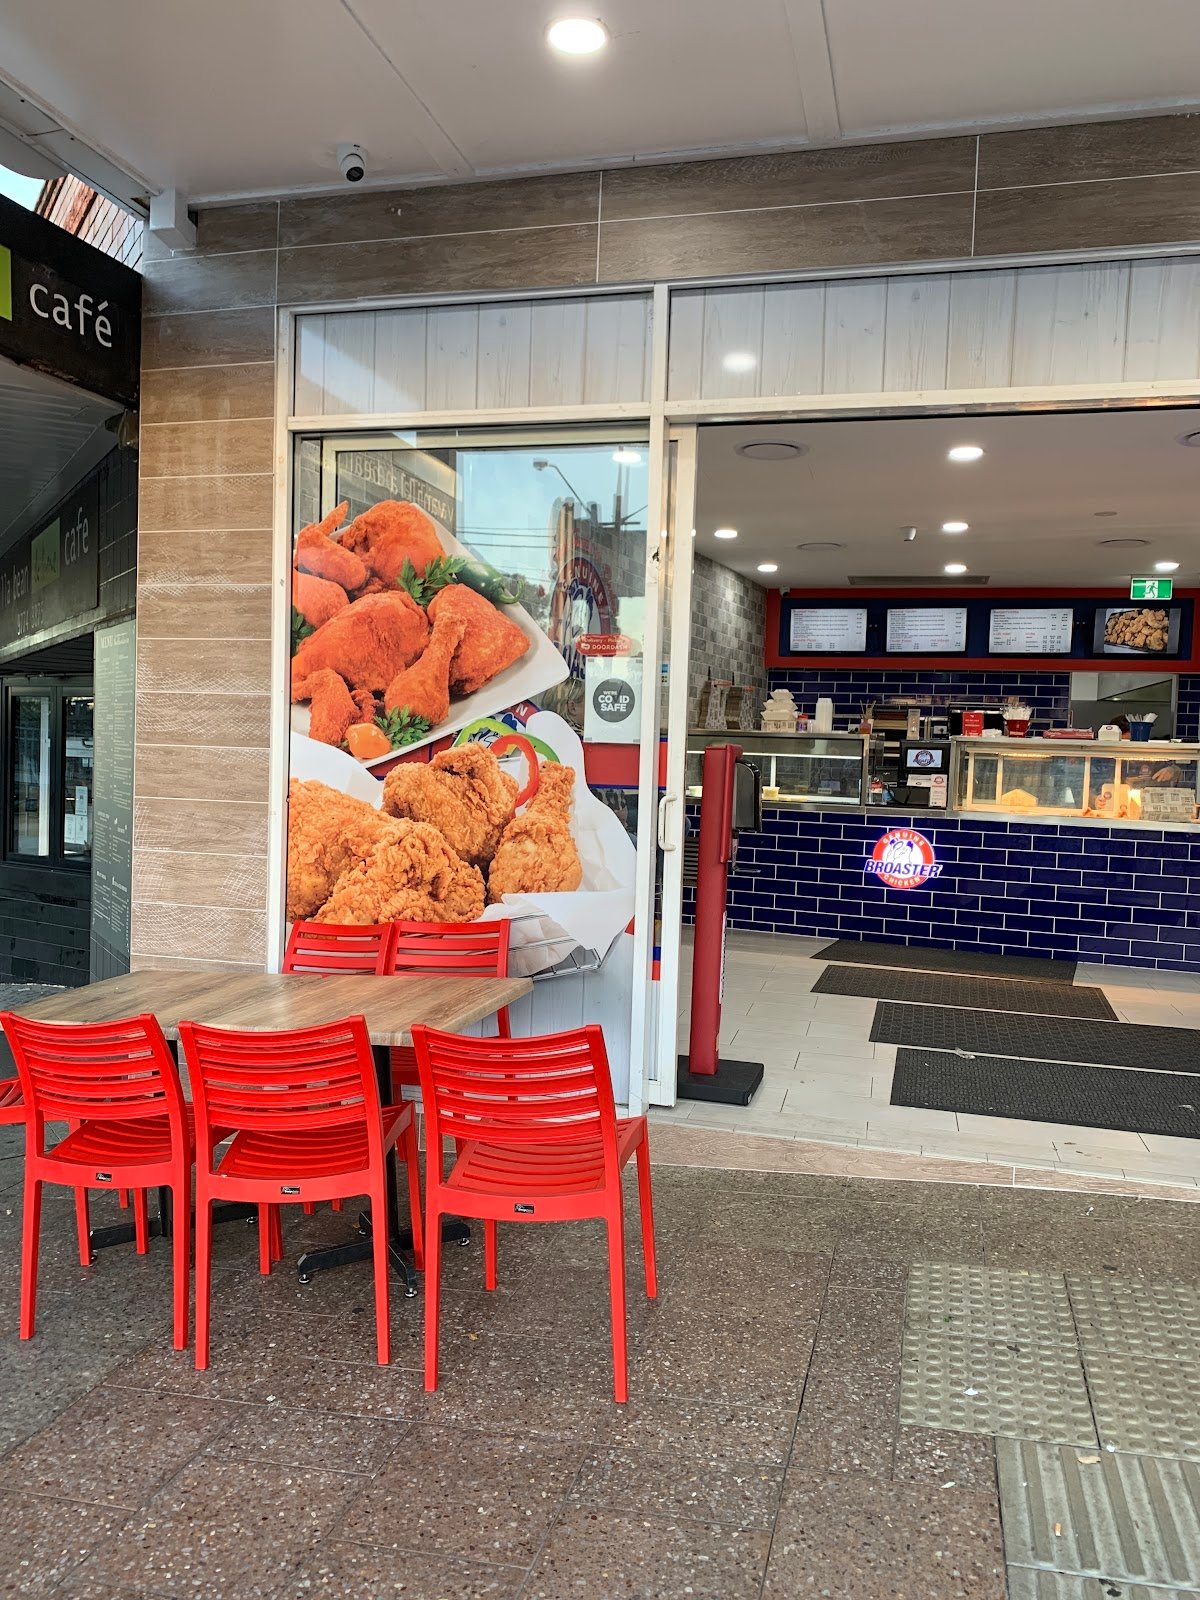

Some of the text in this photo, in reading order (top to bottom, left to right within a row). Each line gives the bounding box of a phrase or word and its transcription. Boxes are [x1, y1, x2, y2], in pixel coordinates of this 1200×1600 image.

[29, 283, 112, 348] café
[600, 703, 627, 712] SAFE
[882, 832, 925, 847] GENUINE
[864, 860, 941, 878] BROASTER
[883, 874, 921, 887] CHICKEN
